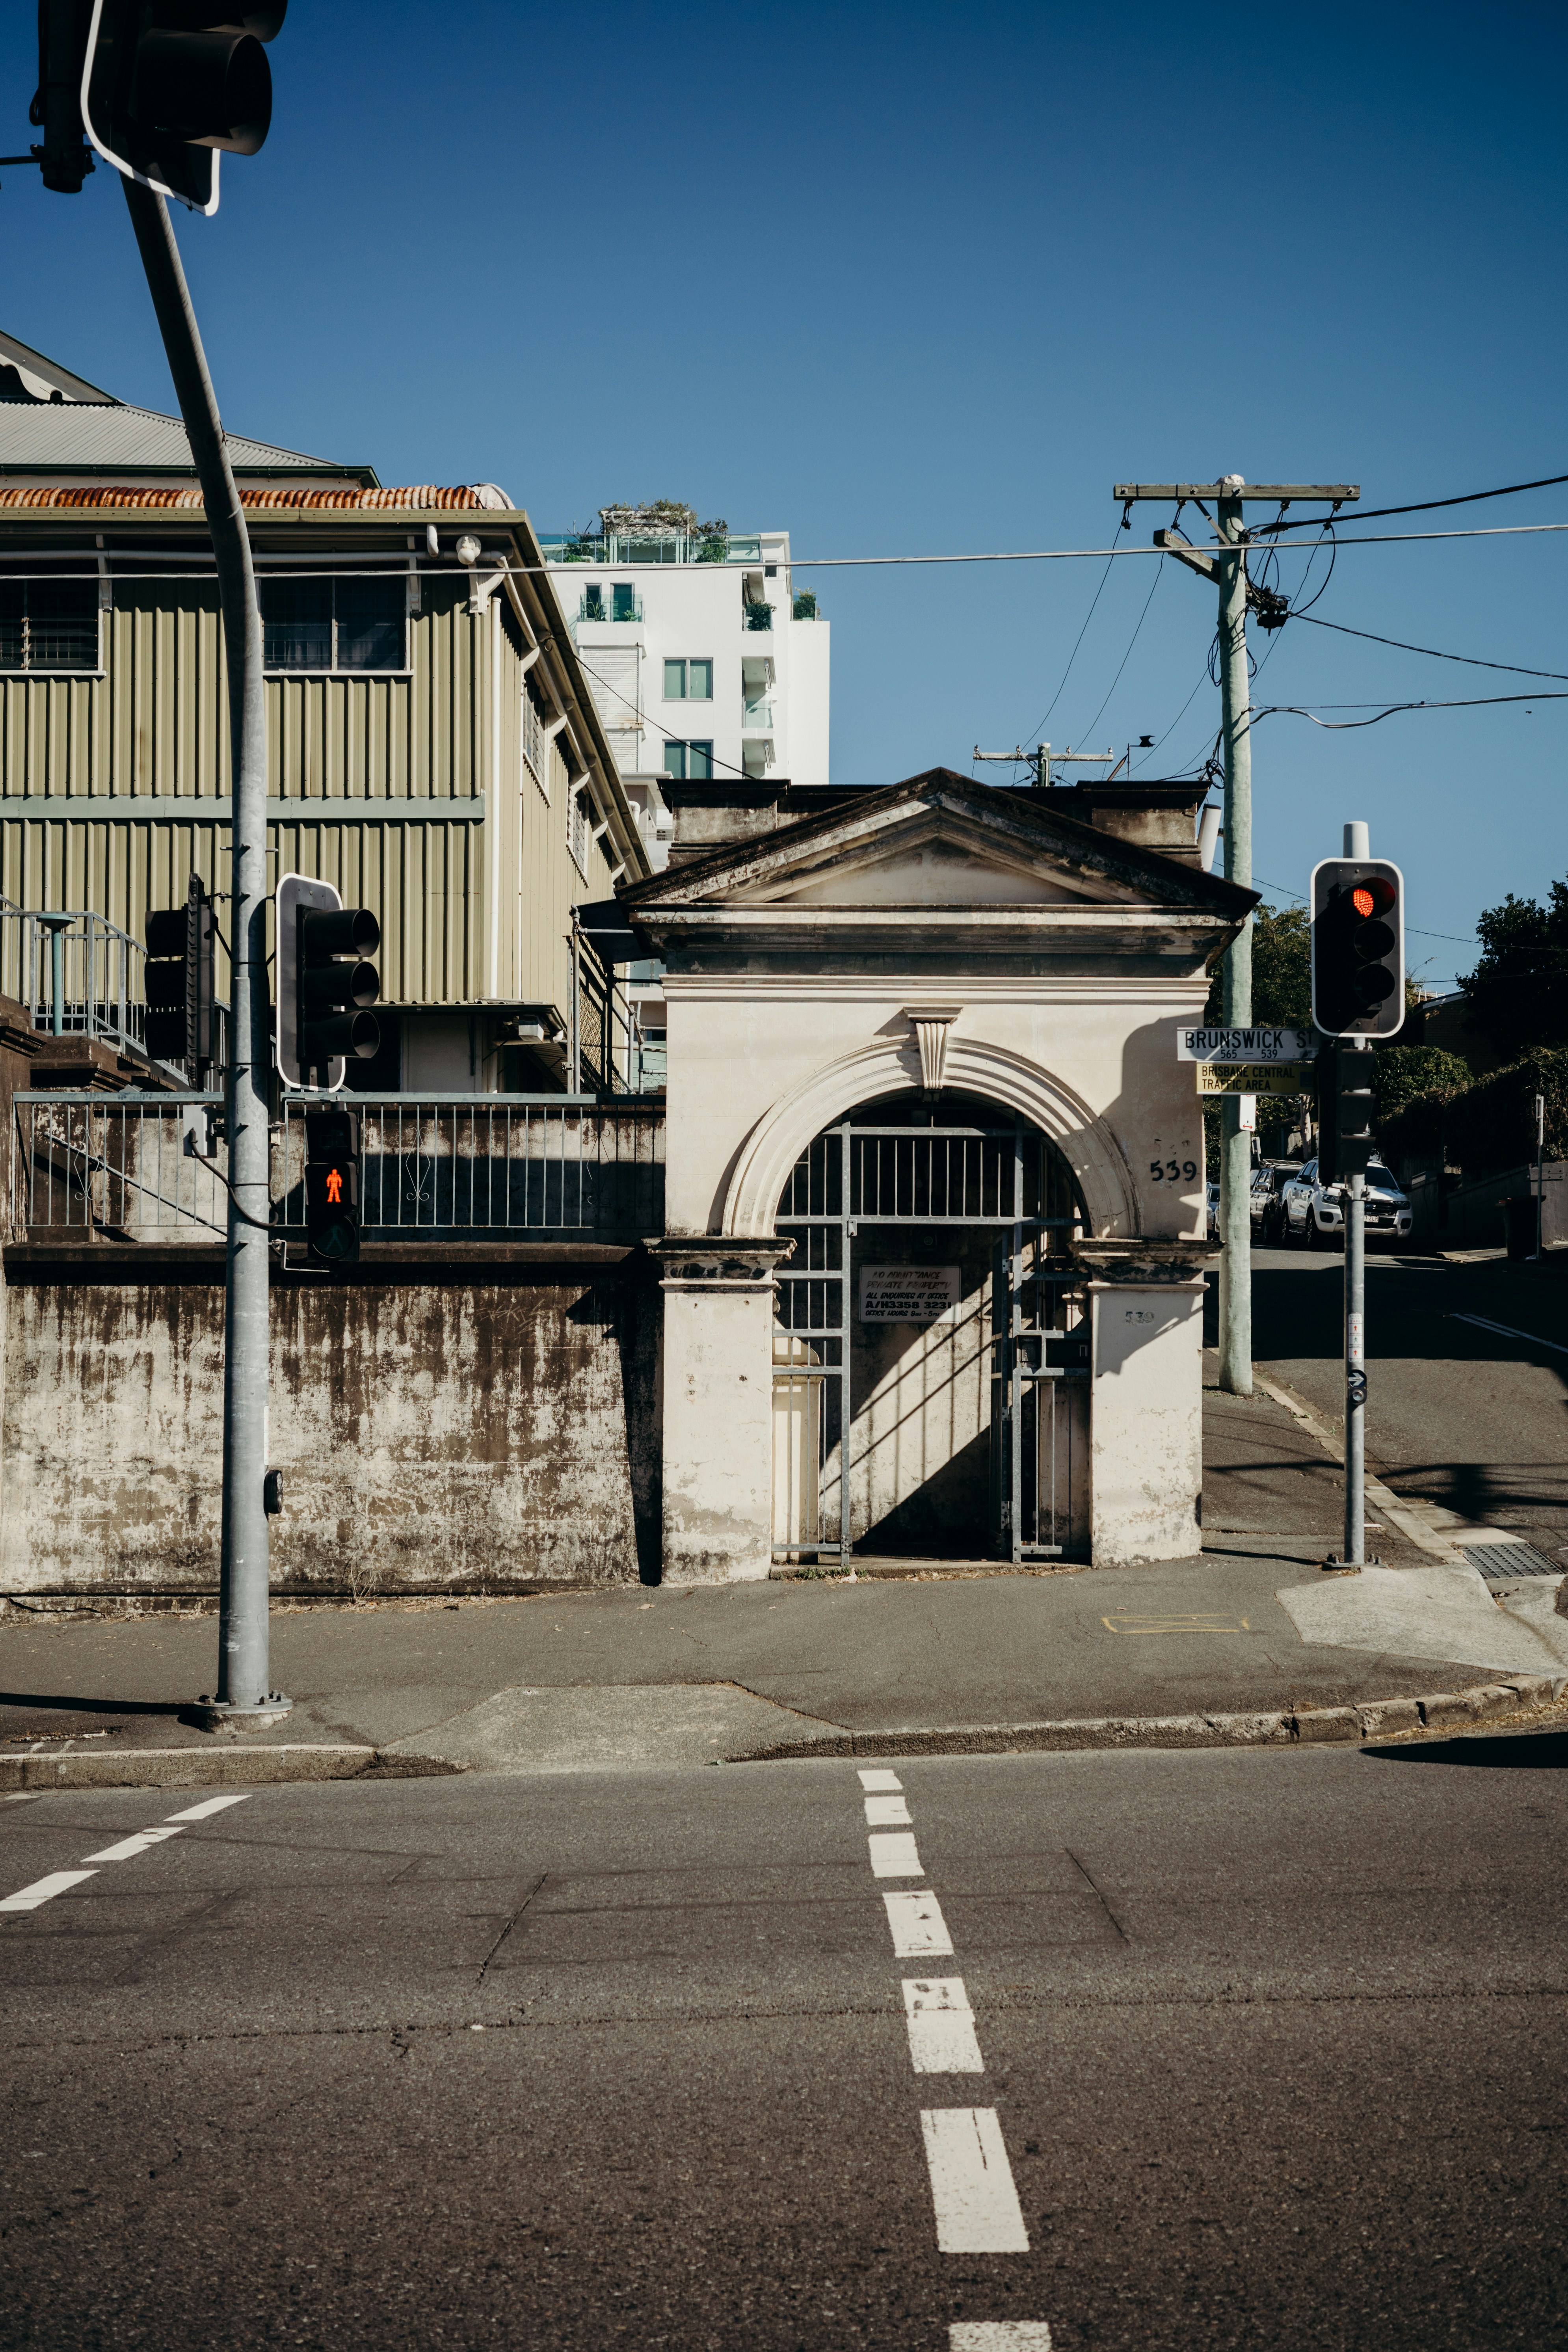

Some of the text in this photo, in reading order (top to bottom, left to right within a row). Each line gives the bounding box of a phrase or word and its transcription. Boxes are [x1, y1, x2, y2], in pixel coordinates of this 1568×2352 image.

[1185, 1031, 1313, 1049] BRUNSWICK ST
[1221, 1049, 1237, 1059] 565
[1261, 1049, 1278, 1059] 539
[1202, 1066, 1295, 1078] BRISBANE CENTRAL
[1202, 1079, 1271, 1090] TRAFFIC AREA
[1150, 1160, 1197, 1181] 539
